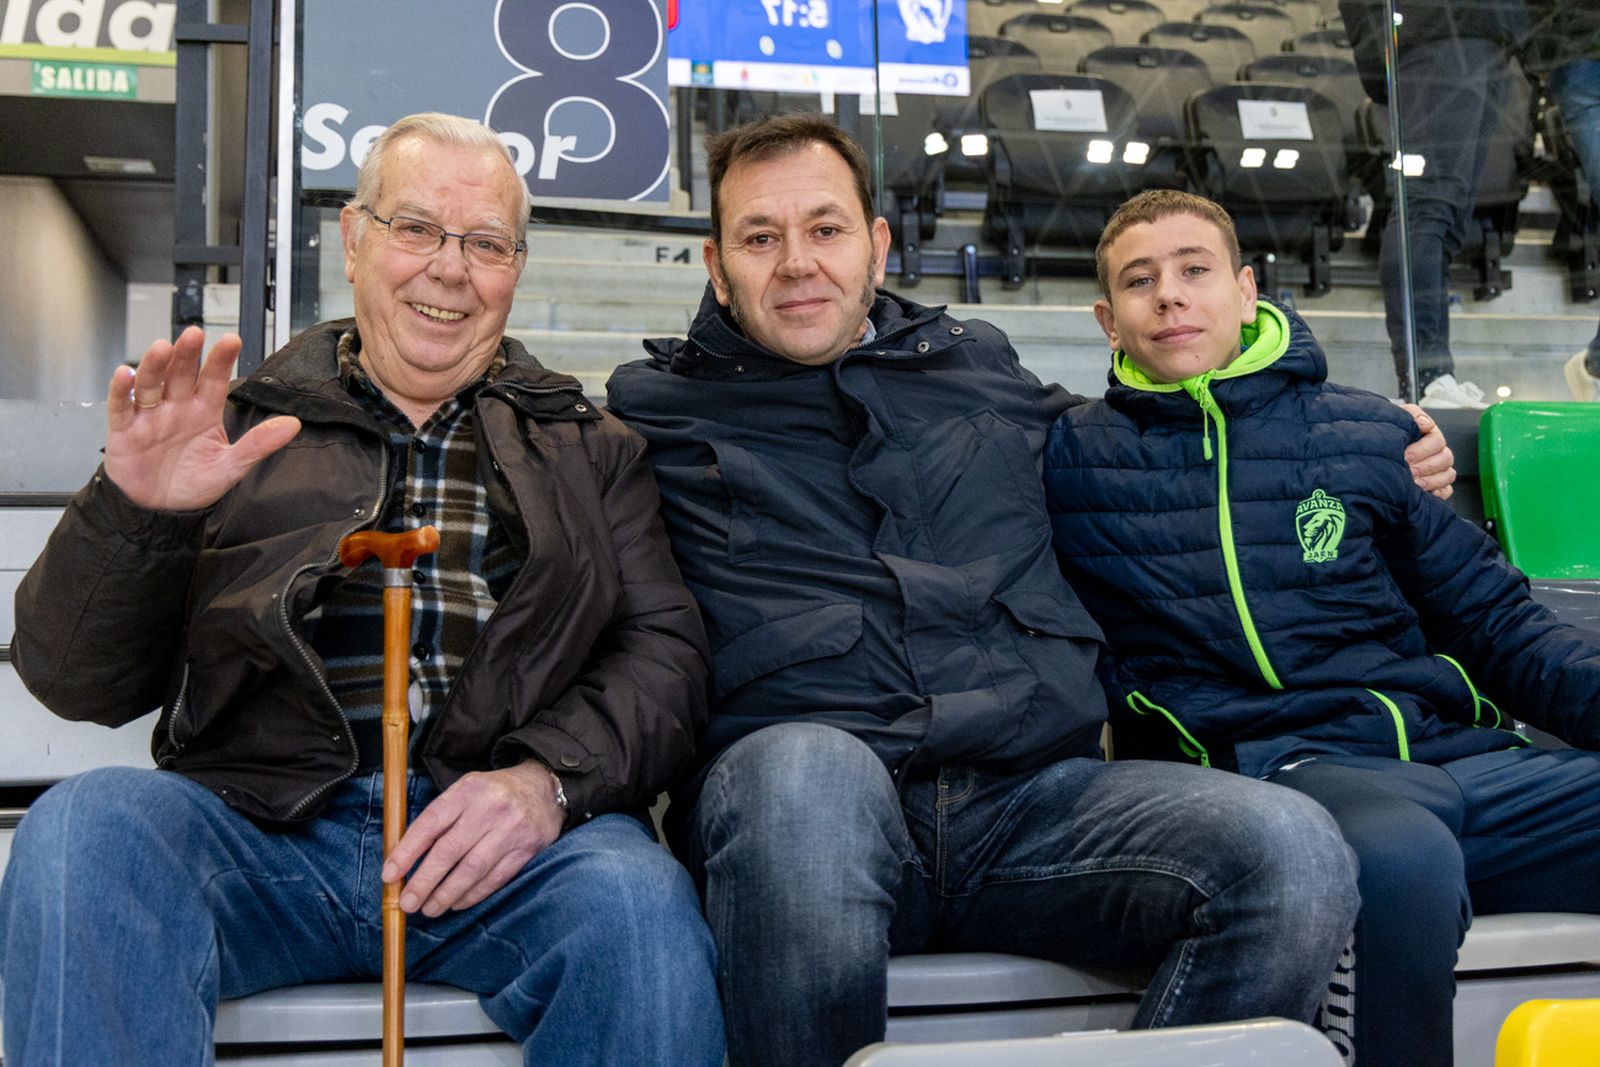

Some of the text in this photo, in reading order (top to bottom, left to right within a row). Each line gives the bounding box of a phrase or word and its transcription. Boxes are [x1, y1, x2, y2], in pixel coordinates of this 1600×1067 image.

[39, 65, 130, 93] SALIDA
[485, 0, 671, 201] 8
[301, 102, 577, 181] Seor
[1296, 500, 1344, 516] AVANZA
